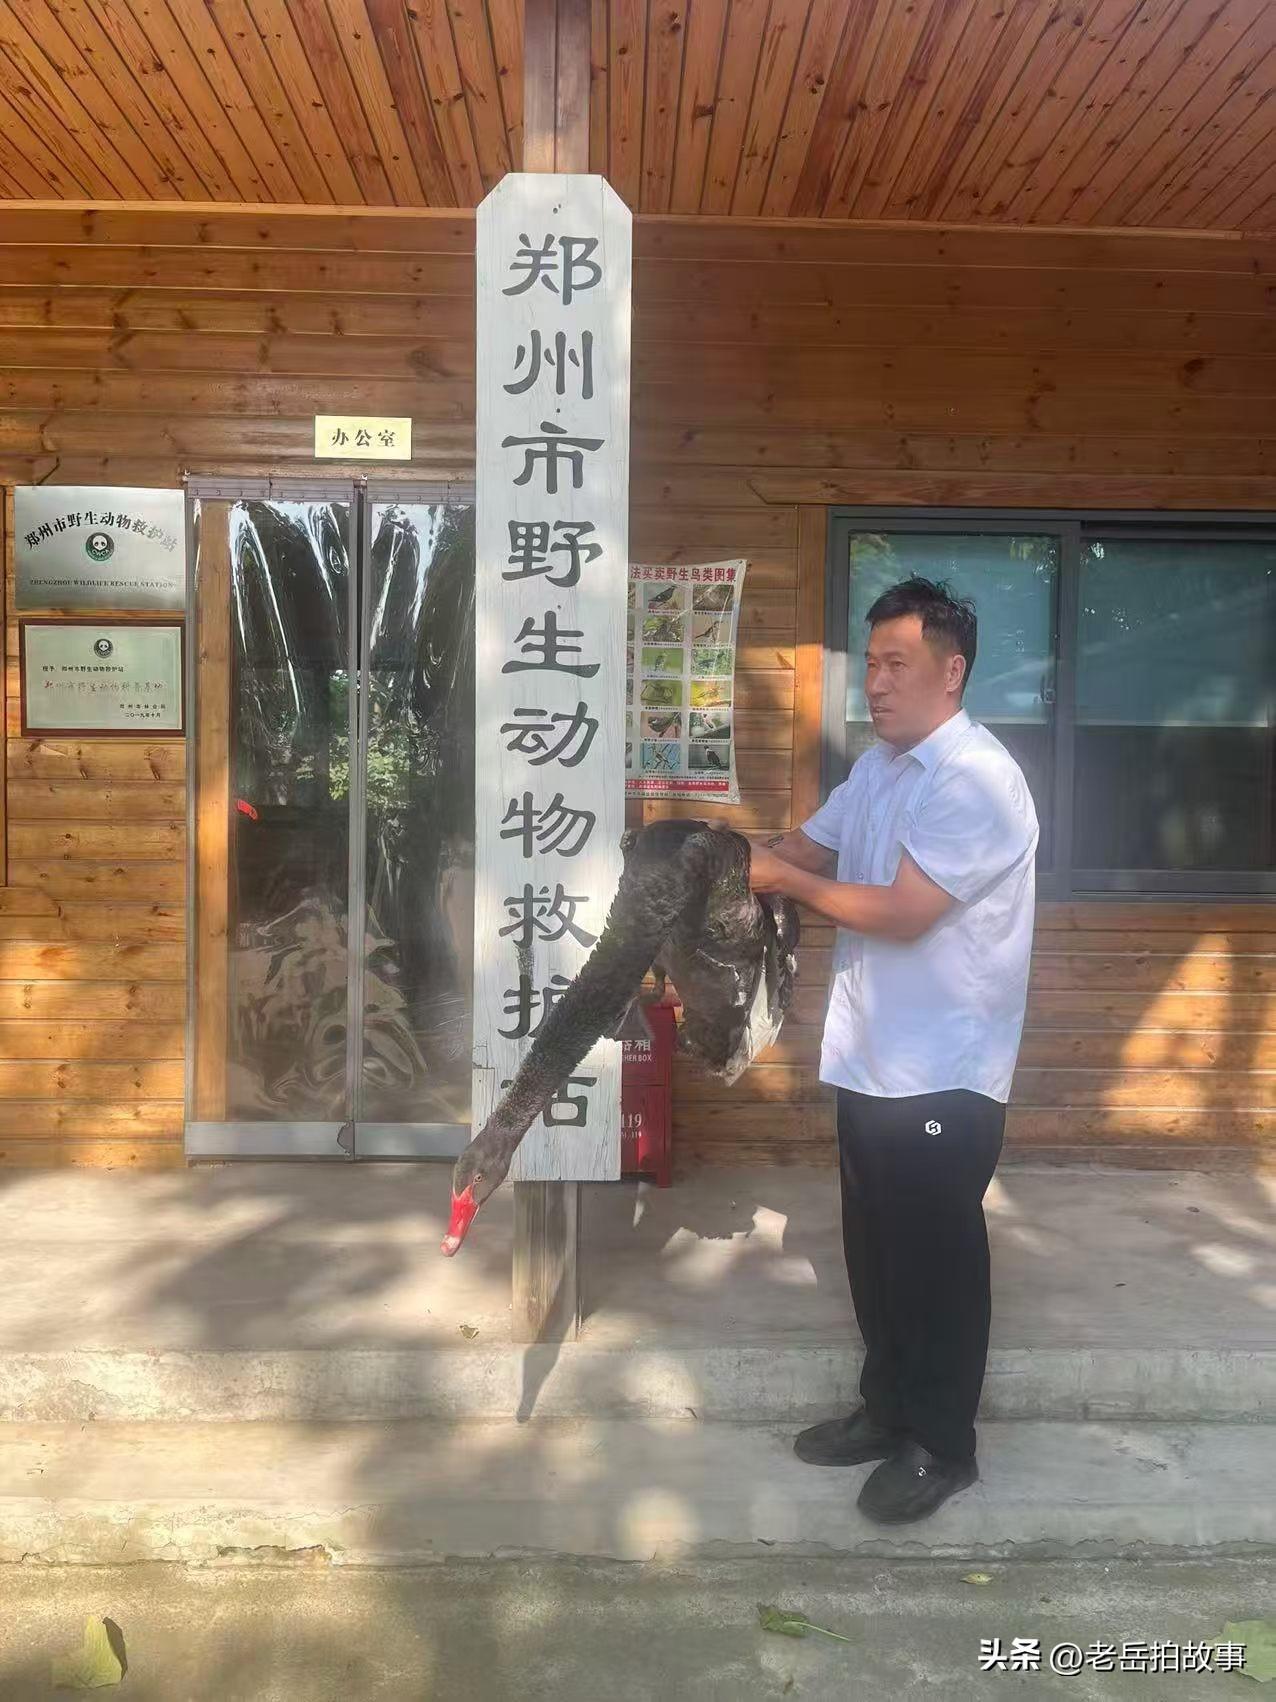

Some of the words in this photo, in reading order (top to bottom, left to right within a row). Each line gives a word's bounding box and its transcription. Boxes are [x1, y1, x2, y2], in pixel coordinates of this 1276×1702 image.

[331, 428, 398, 447] 办公室
[24, 511, 178, 552] 郑州市野生动物救护站
[630, 566, 737, 582] 法买卖野生鸟类图集
[638, 1053, 652, 1062] BOX
